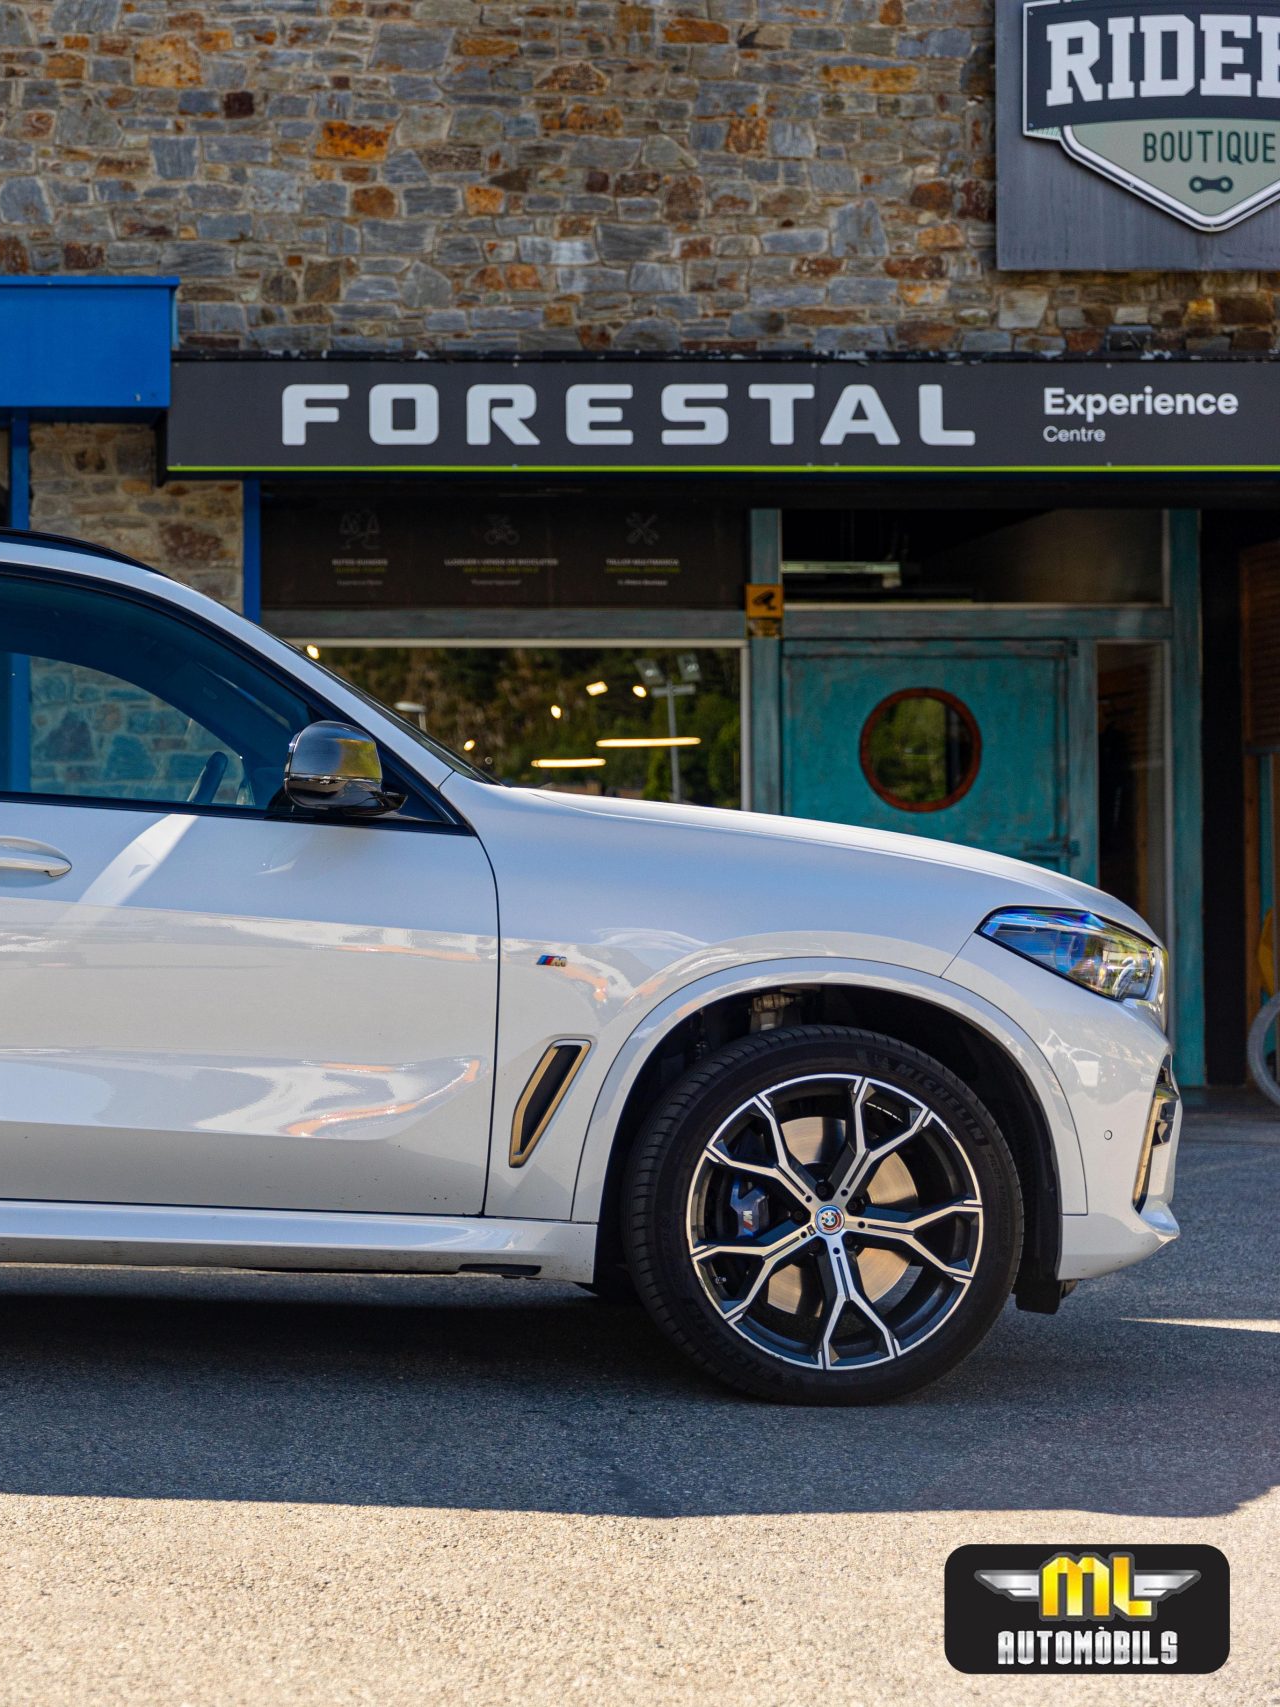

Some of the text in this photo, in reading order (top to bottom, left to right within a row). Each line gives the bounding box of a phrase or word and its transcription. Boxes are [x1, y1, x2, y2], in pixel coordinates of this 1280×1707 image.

[1143, 131, 1277, 165] BOUTIQUE
[281, 383, 976, 446] FORESTAL
[1042, 386, 1240, 422] Experience
[1042, 426, 1107, 443] Centre
[895, 1062, 986, 1142] MICHELIN
